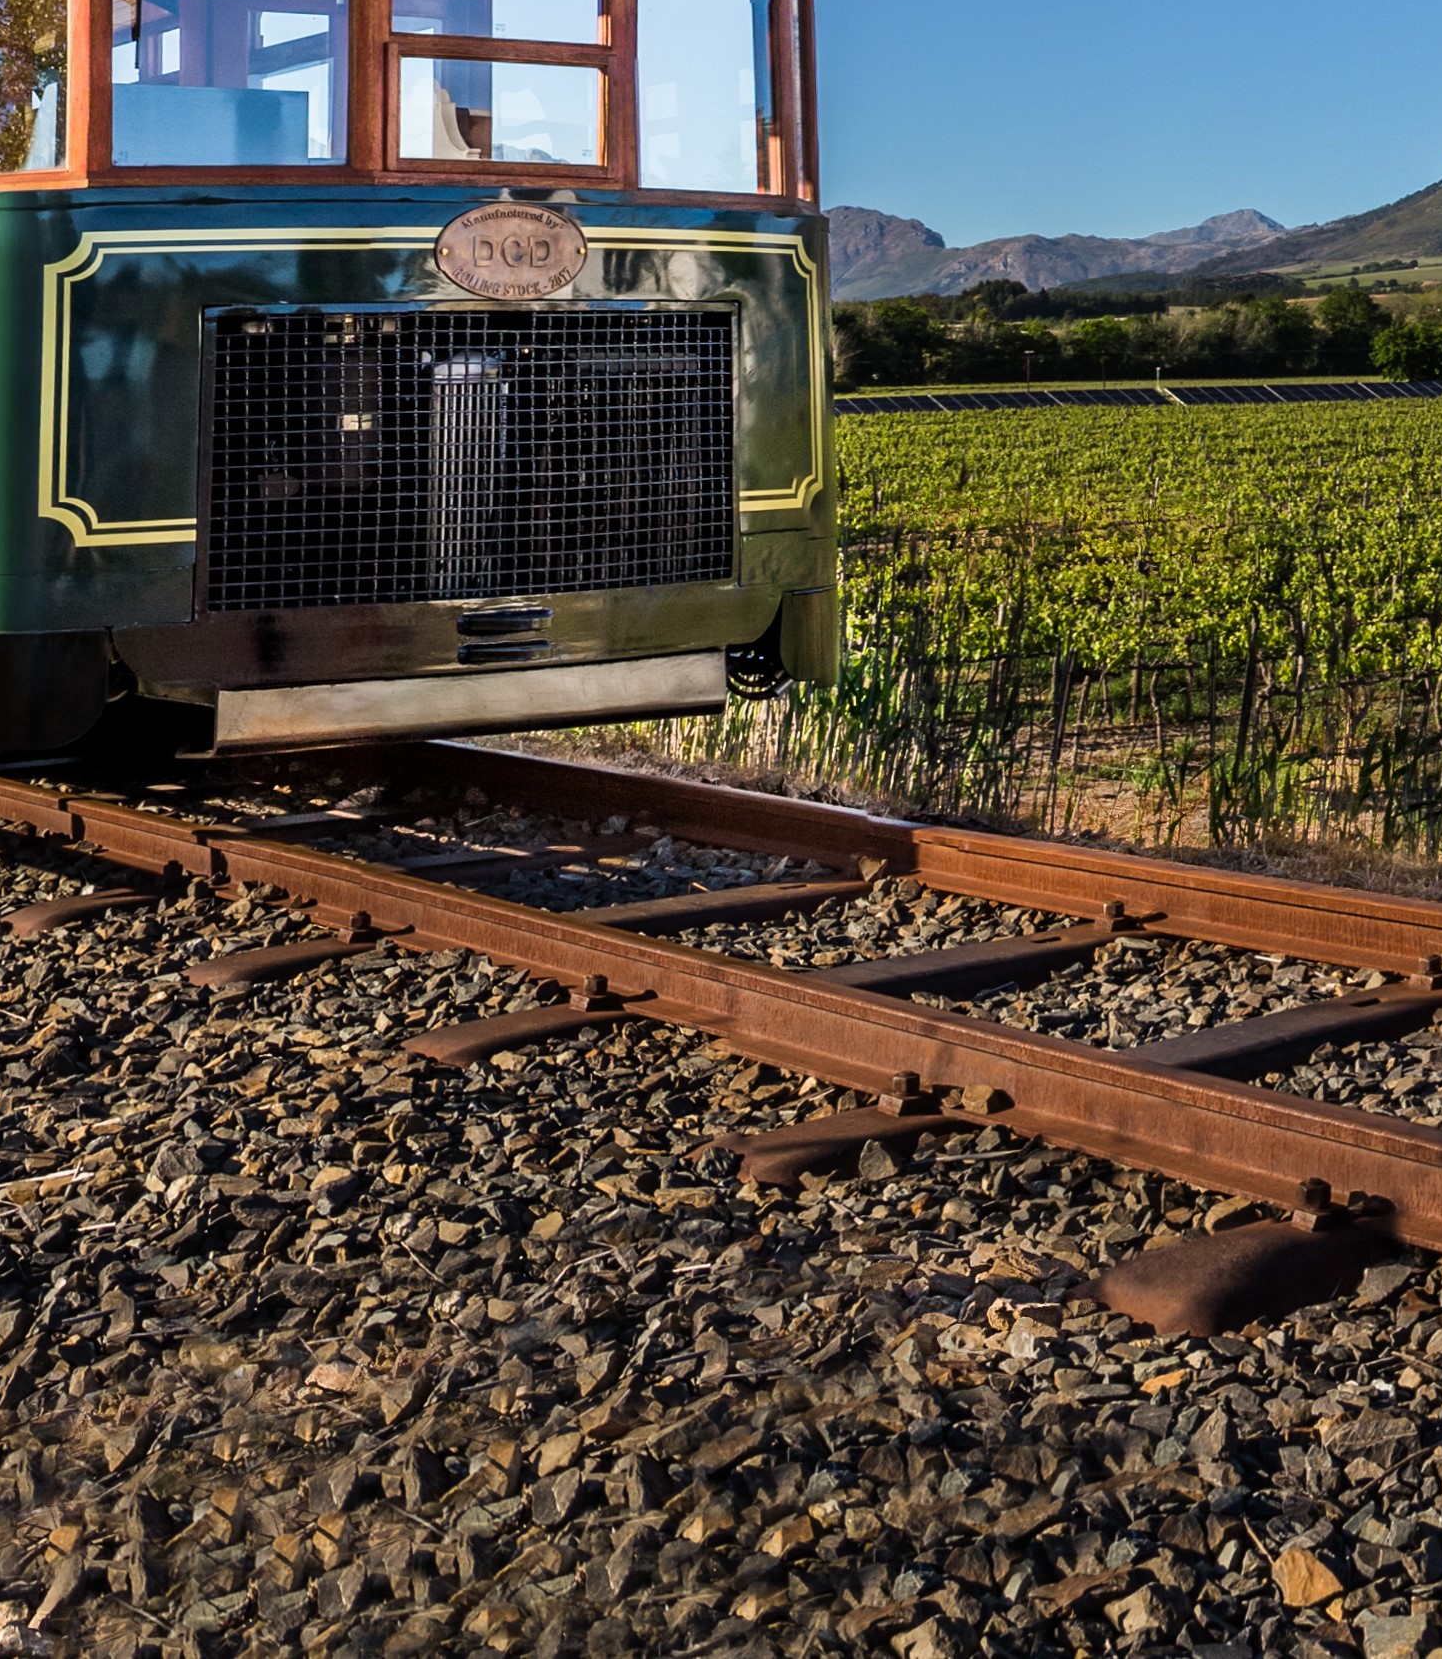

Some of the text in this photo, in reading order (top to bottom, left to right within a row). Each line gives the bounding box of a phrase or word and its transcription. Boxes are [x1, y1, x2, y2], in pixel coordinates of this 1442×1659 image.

[461, 209, 544, 230] Manufactured
[472, 234, 551, 268] DCD
[452, 265, 501, 295] ROLLING
[503, 282, 543, 297] STOCK
